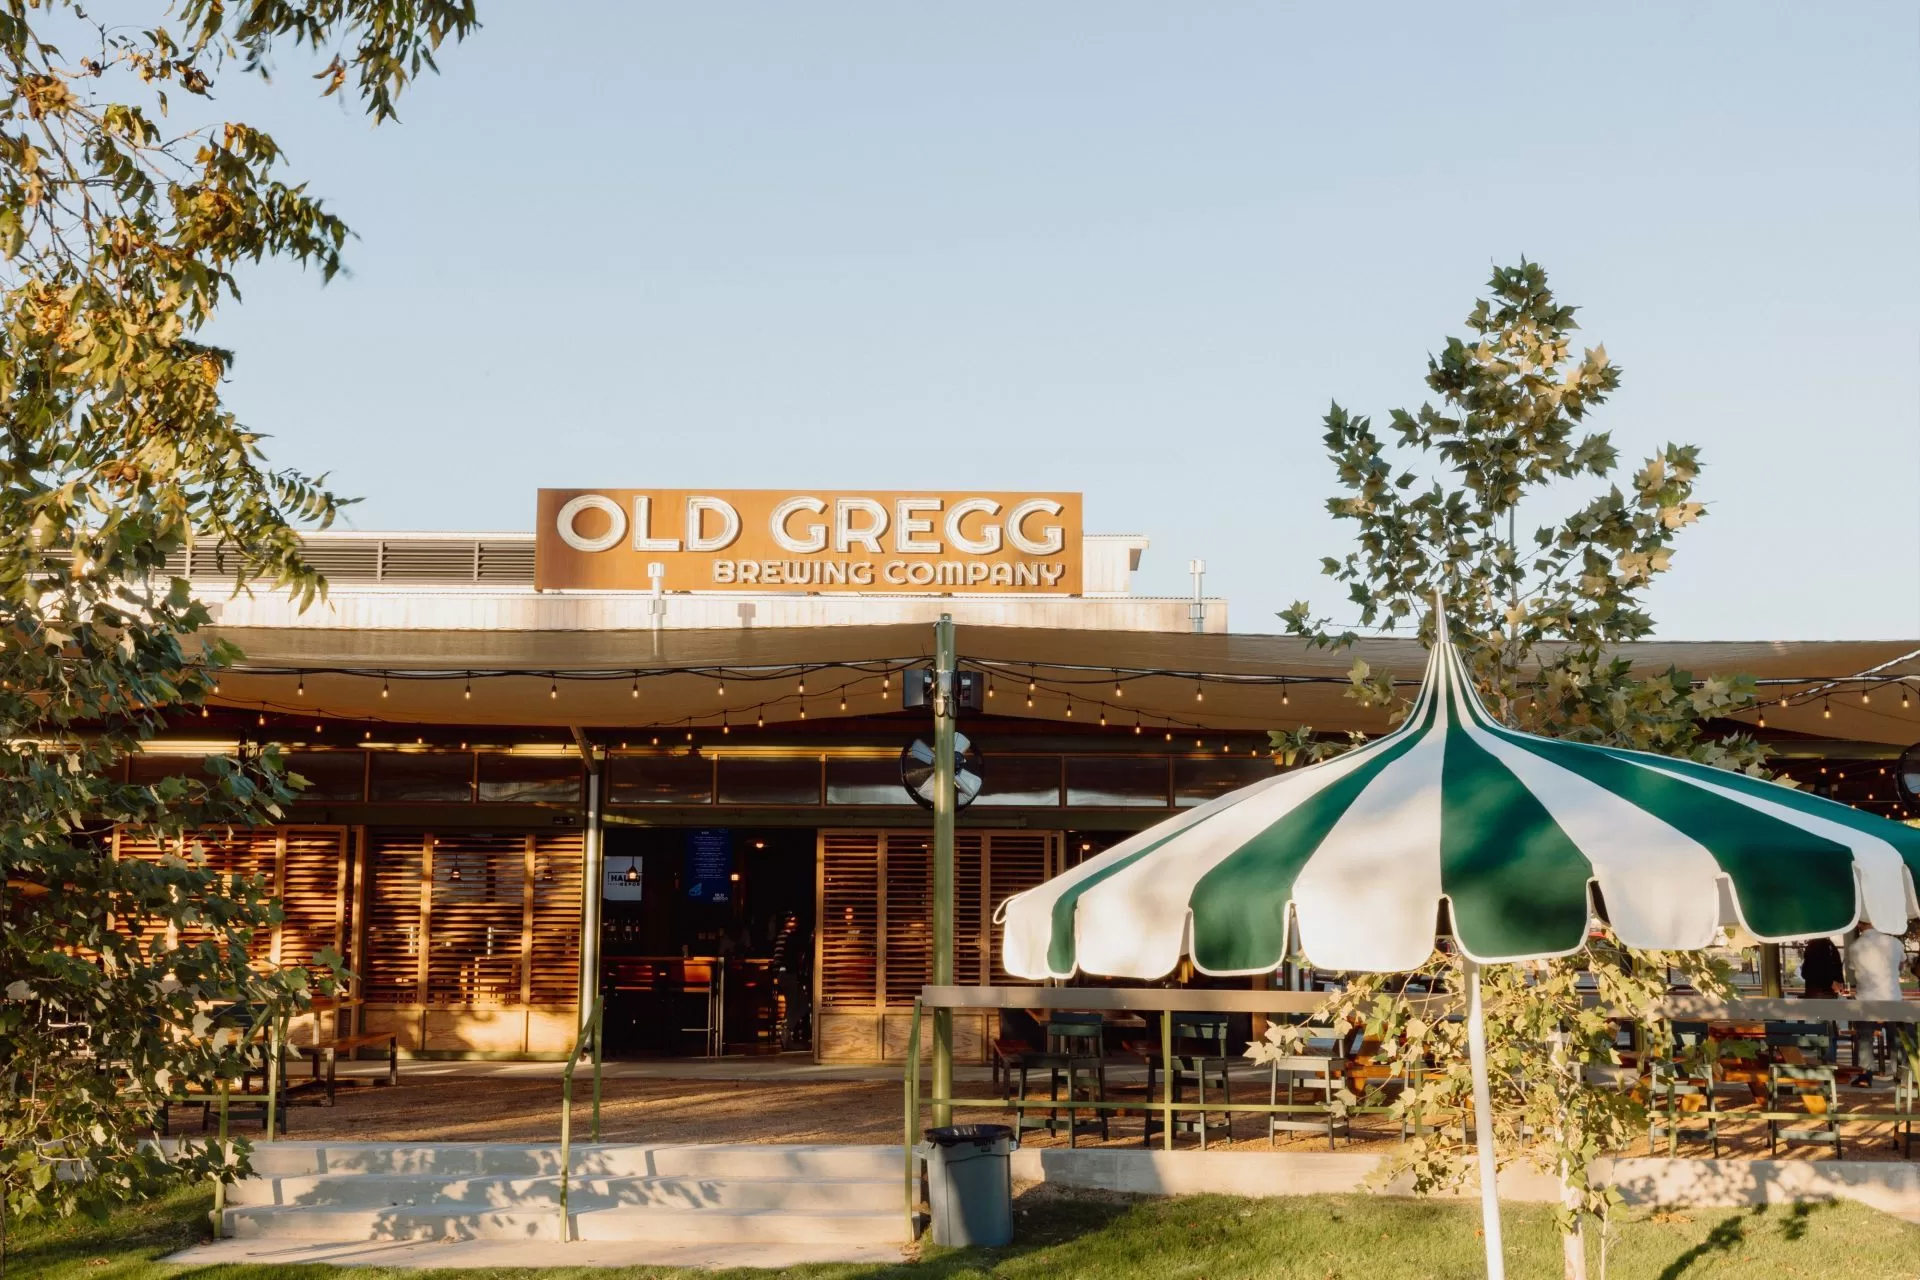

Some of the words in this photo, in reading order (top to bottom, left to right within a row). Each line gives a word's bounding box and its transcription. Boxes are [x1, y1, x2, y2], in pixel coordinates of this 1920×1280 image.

[557, 494, 741, 553] OLD
[769, 496, 1064, 555] GREGG
[713, 560, 874, 586] BREWING
[883, 560, 1065, 587] COMPANY
